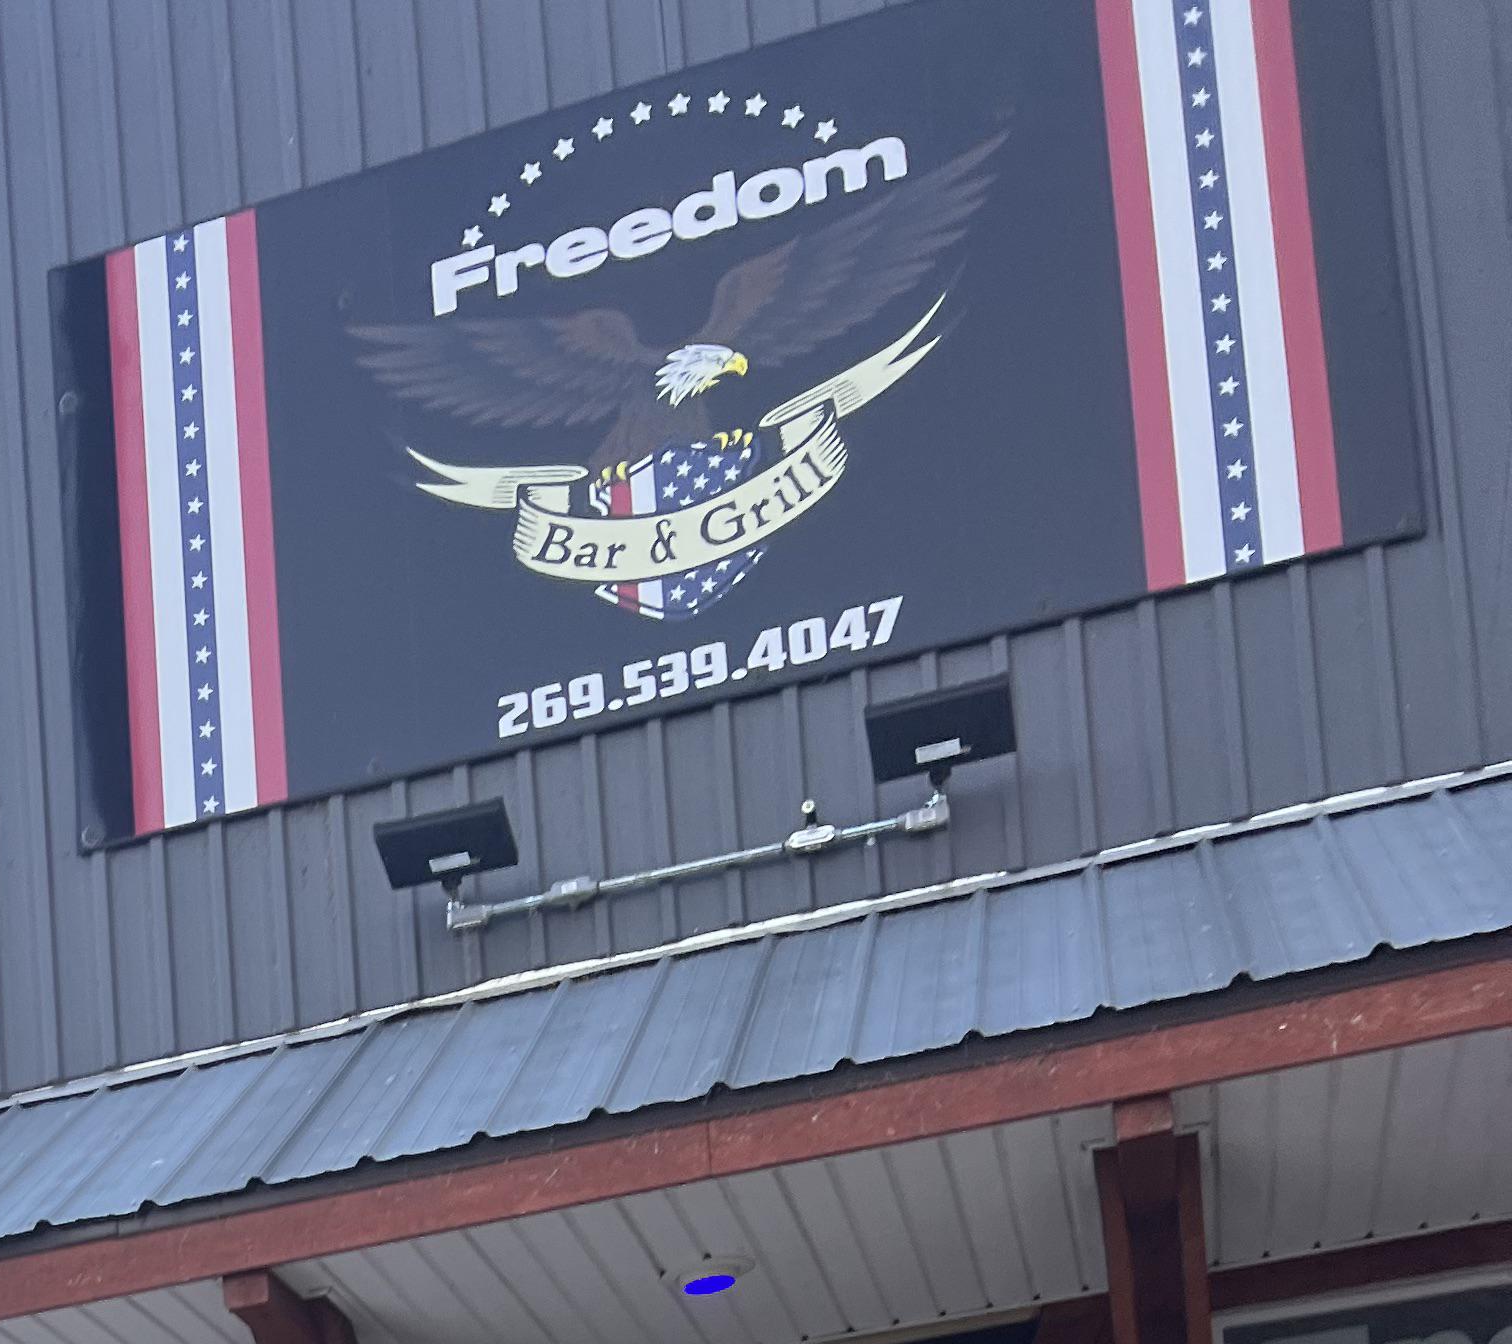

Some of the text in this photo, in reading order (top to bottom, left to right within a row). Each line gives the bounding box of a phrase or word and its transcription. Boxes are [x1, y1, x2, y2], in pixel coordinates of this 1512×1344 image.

[431, 136, 908, 316] Freedom
[531, 451, 836, 570] Bar & Grill
[497, 595, 904, 738] 269.539.4047
